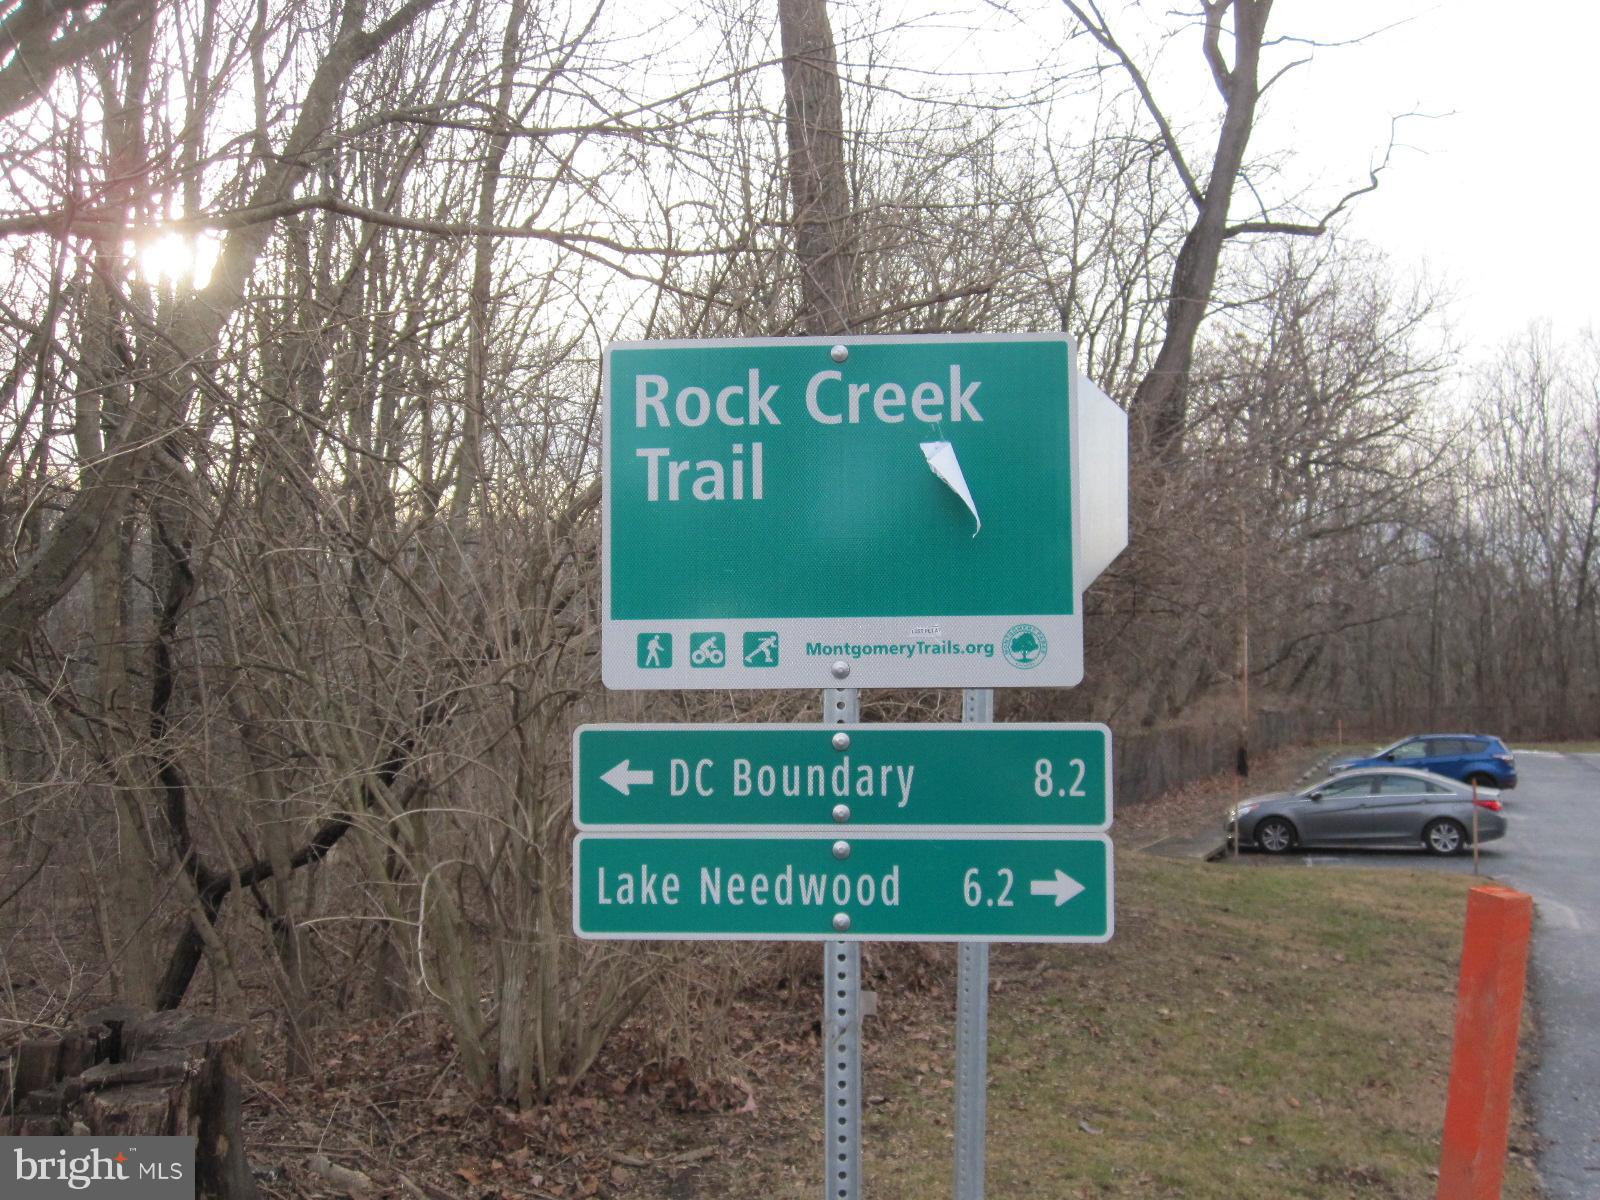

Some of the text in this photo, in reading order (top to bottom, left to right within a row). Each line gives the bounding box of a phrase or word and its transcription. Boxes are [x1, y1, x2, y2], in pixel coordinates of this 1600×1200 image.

[635, 364, 984, 428] Rock Creek
[635, 442, 764, 502] Trail
[806, 640, 995, 659] MontgomeryTrails.org
[670, 757, 1086, 807] DC Boundary 8.2
[598, 865, 1014, 907] Lake Needwood 6.2
